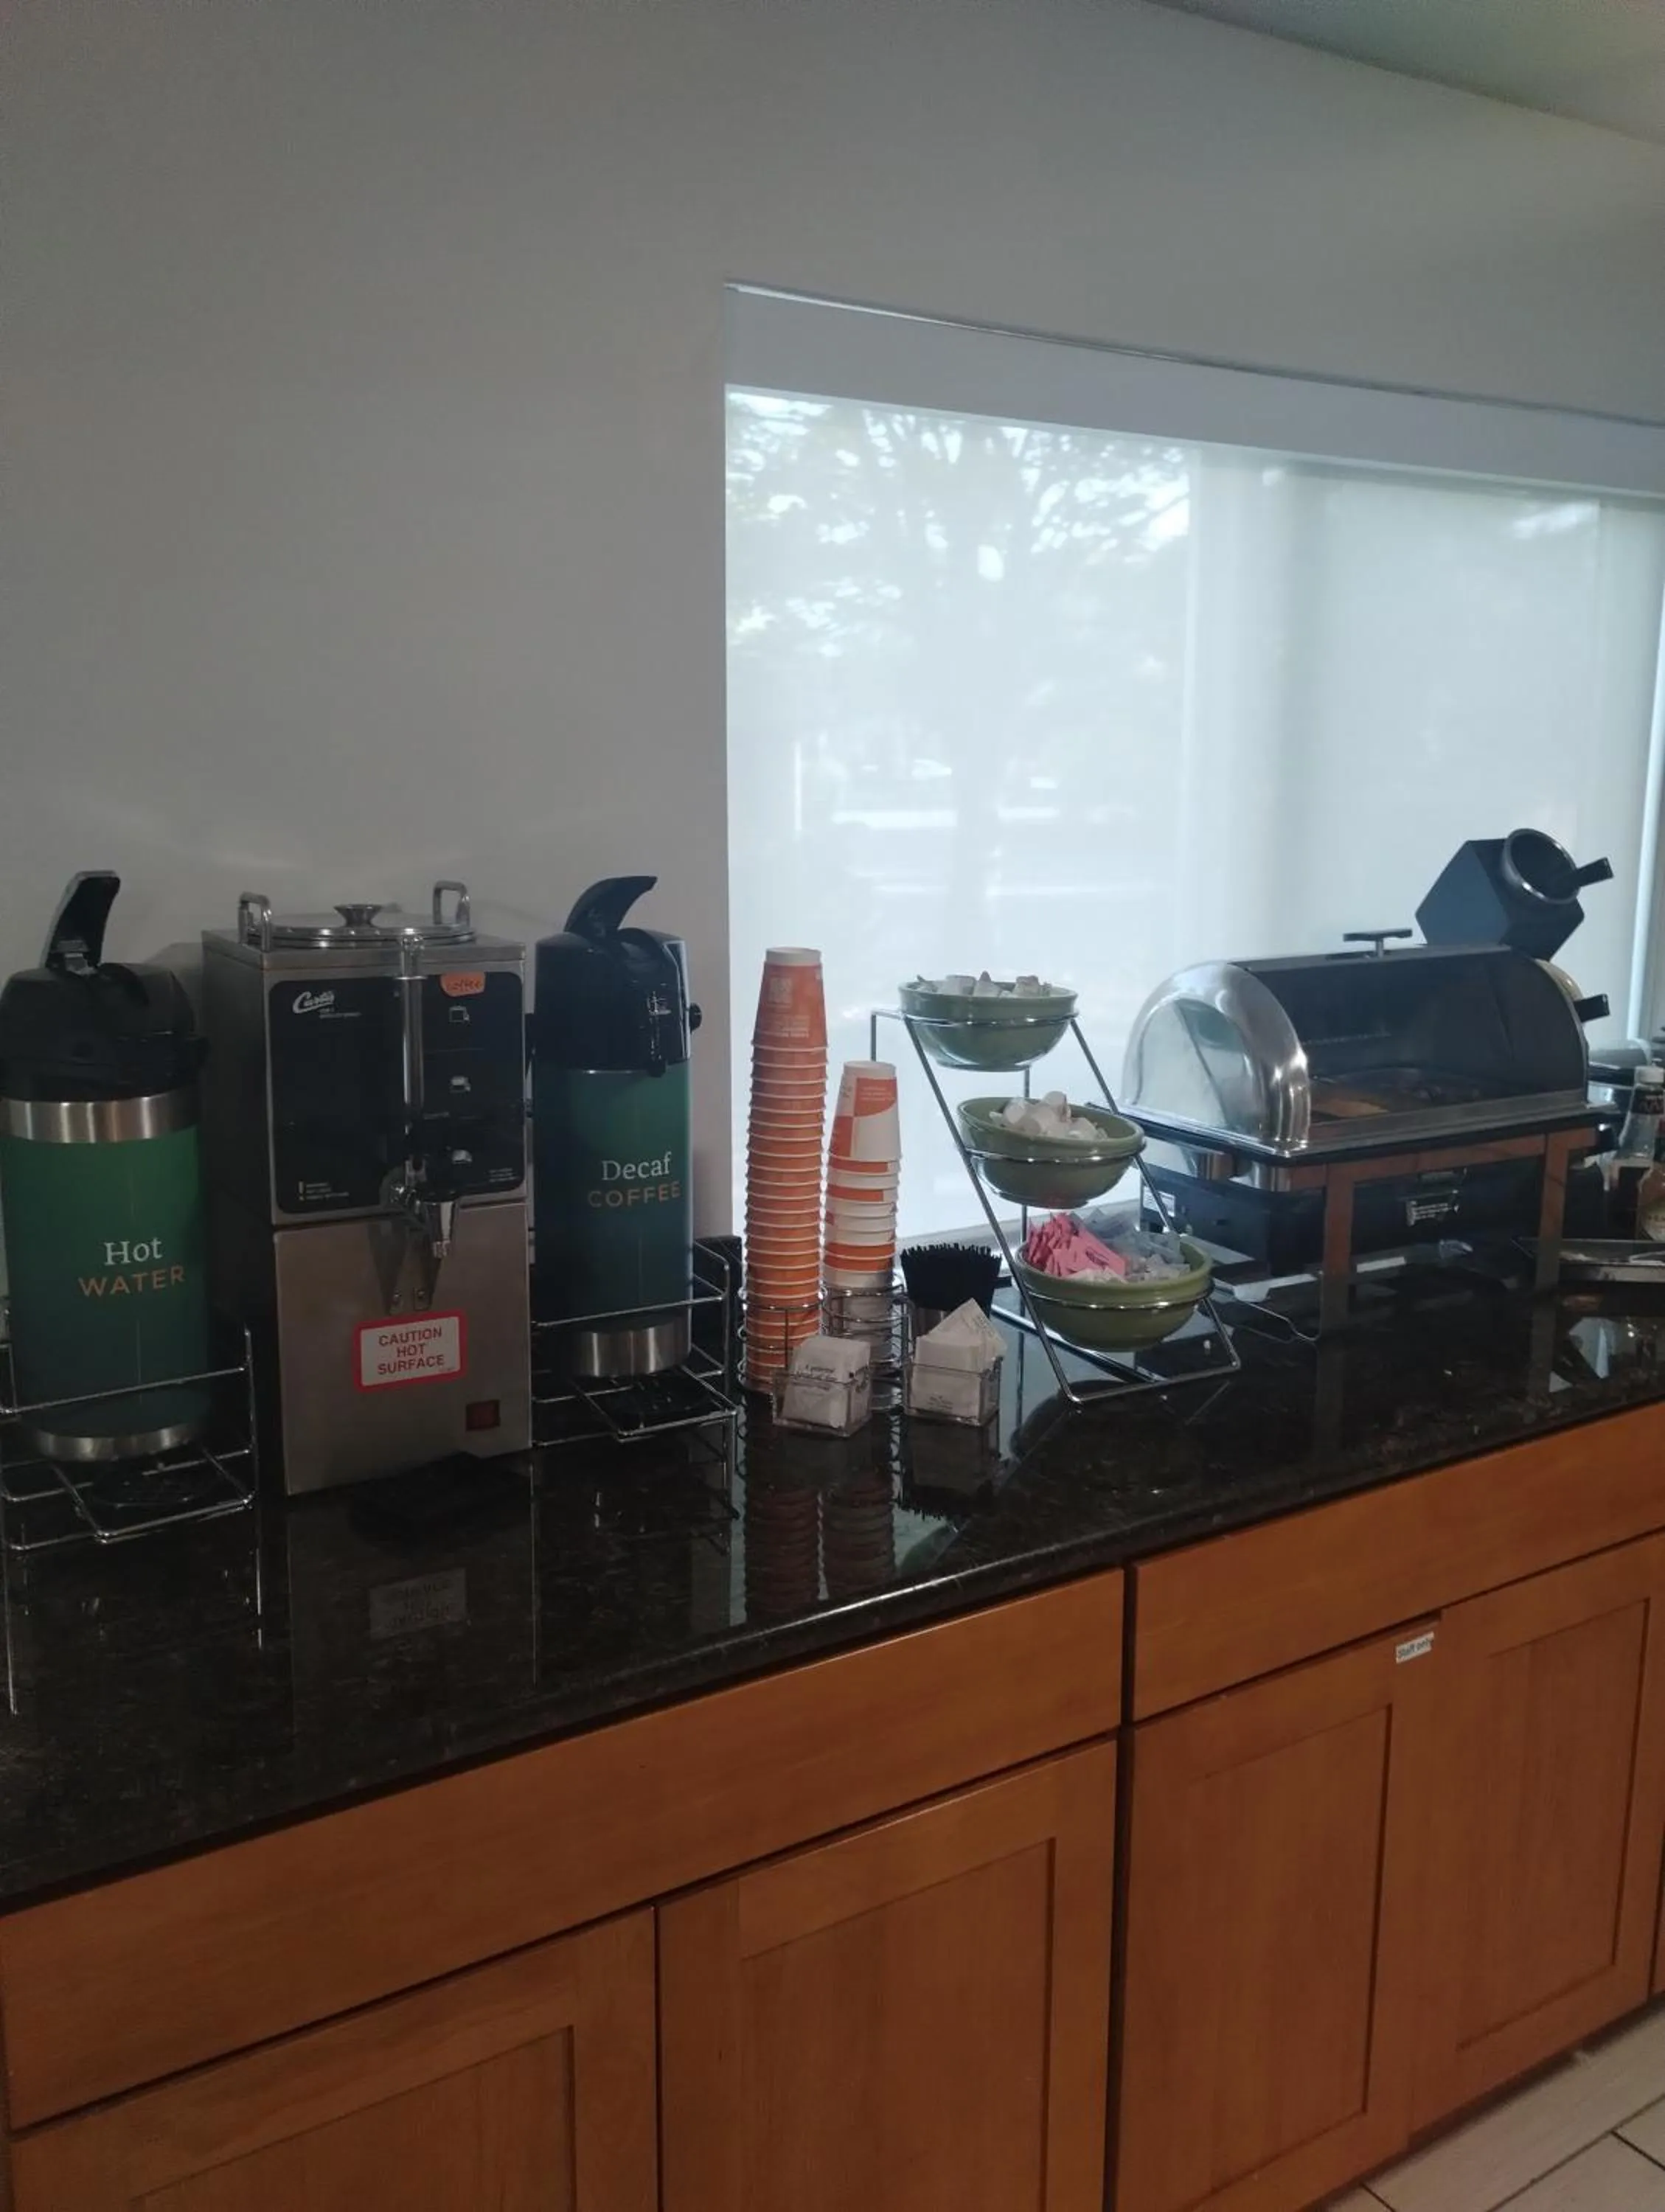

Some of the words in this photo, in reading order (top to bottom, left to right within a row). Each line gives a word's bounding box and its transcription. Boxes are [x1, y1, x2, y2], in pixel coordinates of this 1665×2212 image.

[601, 1150, 672, 1180] Decaf
[588, 1180, 681, 1208] COFFEE
[103, 1237, 163, 1266] Hot
[77, 1265, 185, 1298] WATER
[378, 1326, 442, 1346] CAUTION
[396, 1343, 427, 1357] HOT
[377, 1354, 445, 1375] SURFACE
